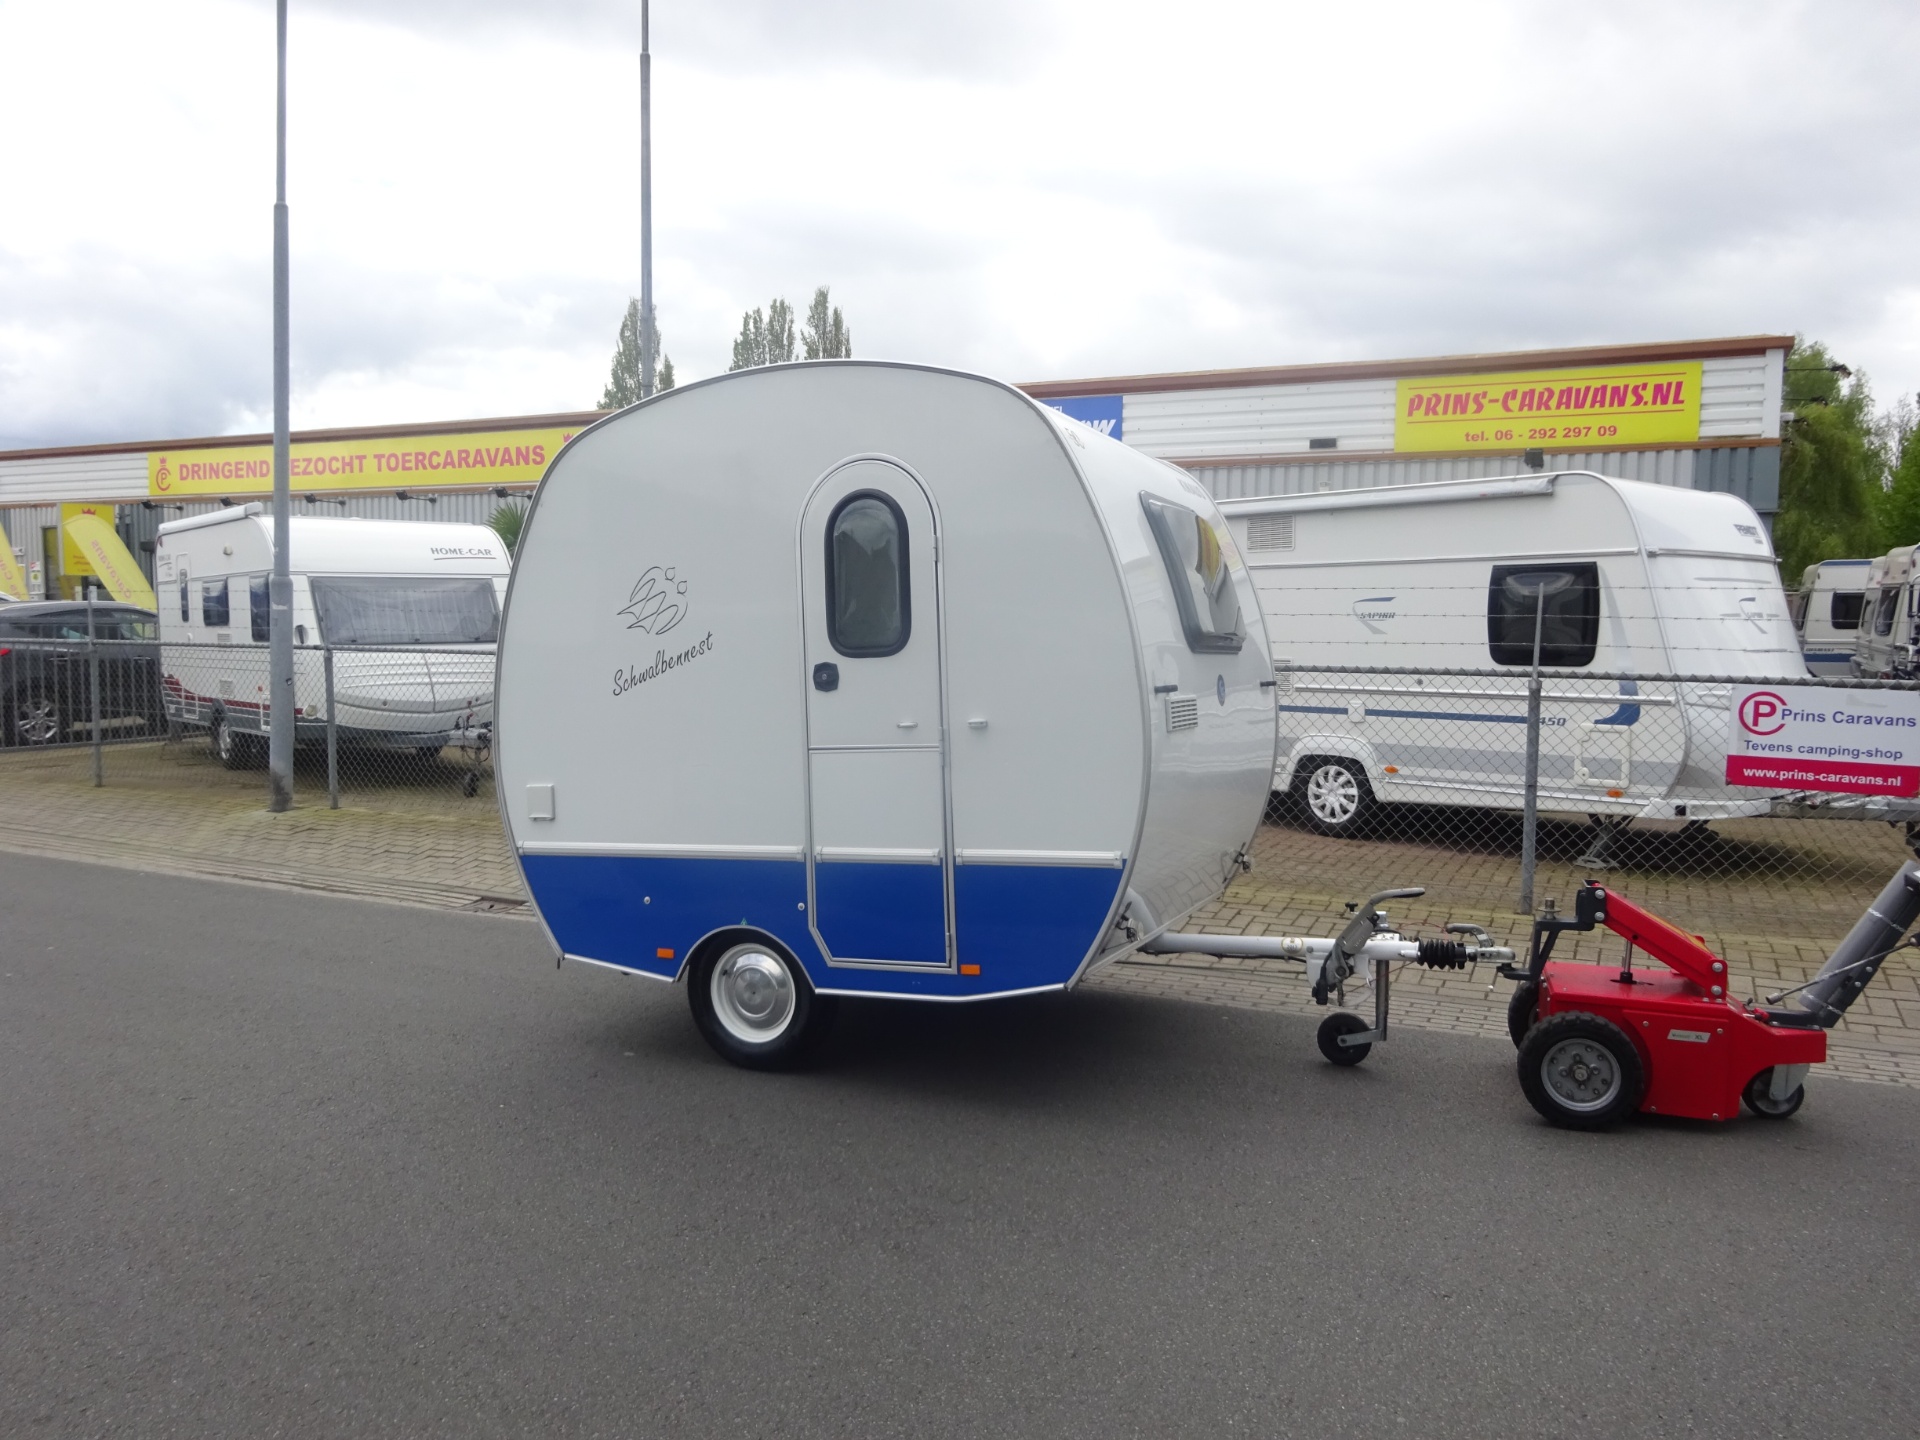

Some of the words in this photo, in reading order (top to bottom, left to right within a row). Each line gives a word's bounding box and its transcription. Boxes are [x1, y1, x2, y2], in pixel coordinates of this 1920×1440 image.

[1407, 381, 1685, 418] PRINS-CARAVANS.NL
[1465, 431, 1489, 442] tel.
[1495, 429, 1513, 441] 06
[1528, 428, 1557, 440] 292
[1562, 426, 1592, 439] 297
[1597, 425, 1618, 437] 09
[179, 460, 270, 481] DRINGEND
[289, 455, 367, 476] EZOCHT
[373, 445, 545, 472] TOERCARAVANS
[430, 547, 492, 556] HOME-CAR
[613, 631, 713, 696] Schwalbennest
[1781, 708, 1826, 723] Prins
[1832, 711, 1917, 727] Caravans
[1744, 740, 1793, 752] Tevens
[1798, 744, 1903, 761] camping-shop
[1743, 767, 1901, 787] www.prins-caravans.nl
